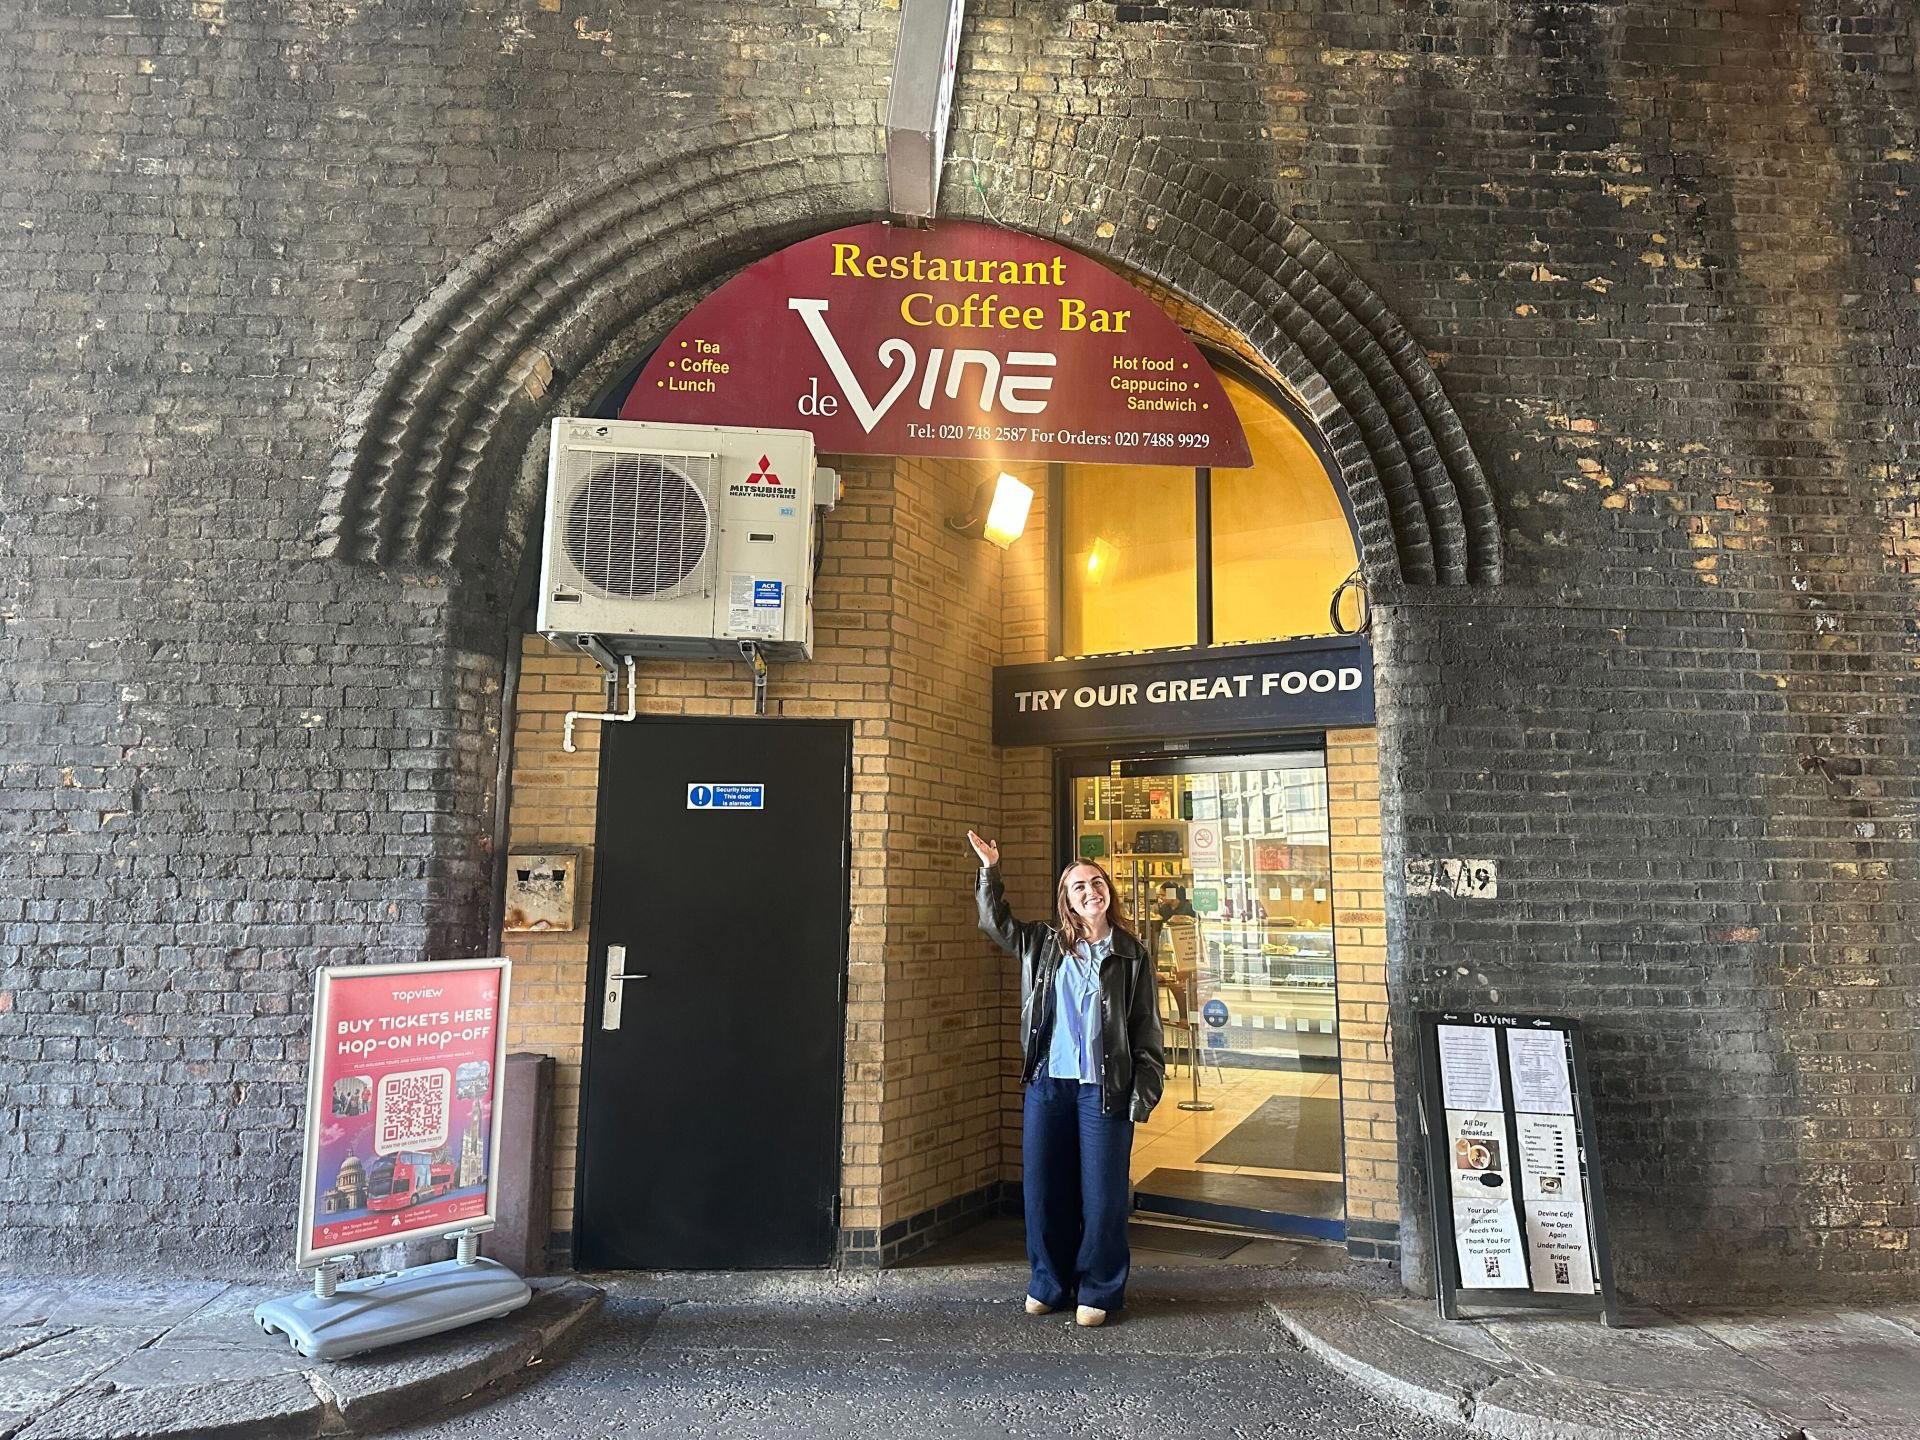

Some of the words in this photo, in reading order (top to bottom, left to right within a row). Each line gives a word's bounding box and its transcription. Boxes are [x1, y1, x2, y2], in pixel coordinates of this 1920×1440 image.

[830, 243, 1067, 286] Restaurant
[900, 292, 1044, 330] Coffee
[1058, 298, 1131, 333] Bar
[695, 339, 720, 354] Tea
[681, 357, 730, 374] Coffee
[1113, 355, 1138, 370] Hot
[1141, 357, 1174, 371] food
[669, 377, 716, 392] Lunch
[1110, 376, 1188, 394] Cappucino
[797, 377, 838, 416] de
[1127, 396, 1197, 412] Sandwich
[907, 423, 935, 439] Tel:
[939, 425, 964, 440] 020
[967, 426, 991, 441] 748
[995, 427, 1028, 442] 2587
[1030, 428, 1055, 443] For
[1057, 429, 1112, 446] Orders:
[1114, 431, 1139, 446] 020
[1142, 432, 1175, 447] 7488
[1178, 433, 1210, 448] 9929
[729, 485, 796, 495] MITSUBISHI
[1014, 688, 1068, 713] TRY
[1073, 683, 1138, 709] OUR
[1145, 674, 1254, 704] GREAT
[1261, 667, 1363, 696] FOOD
[337, 1018, 374, 1035] BUY
[379, 1012, 449, 1031] TICKETS
[454, 1008, 492, 1023] HERE
[338, 1034, 412, 1059] HOP-ON
[417, 1026, 490, 1050] HOP-OFF
[1475, 1120, 1488, 1128] Day
[1557, 1243, 1581, 1251] Railway
